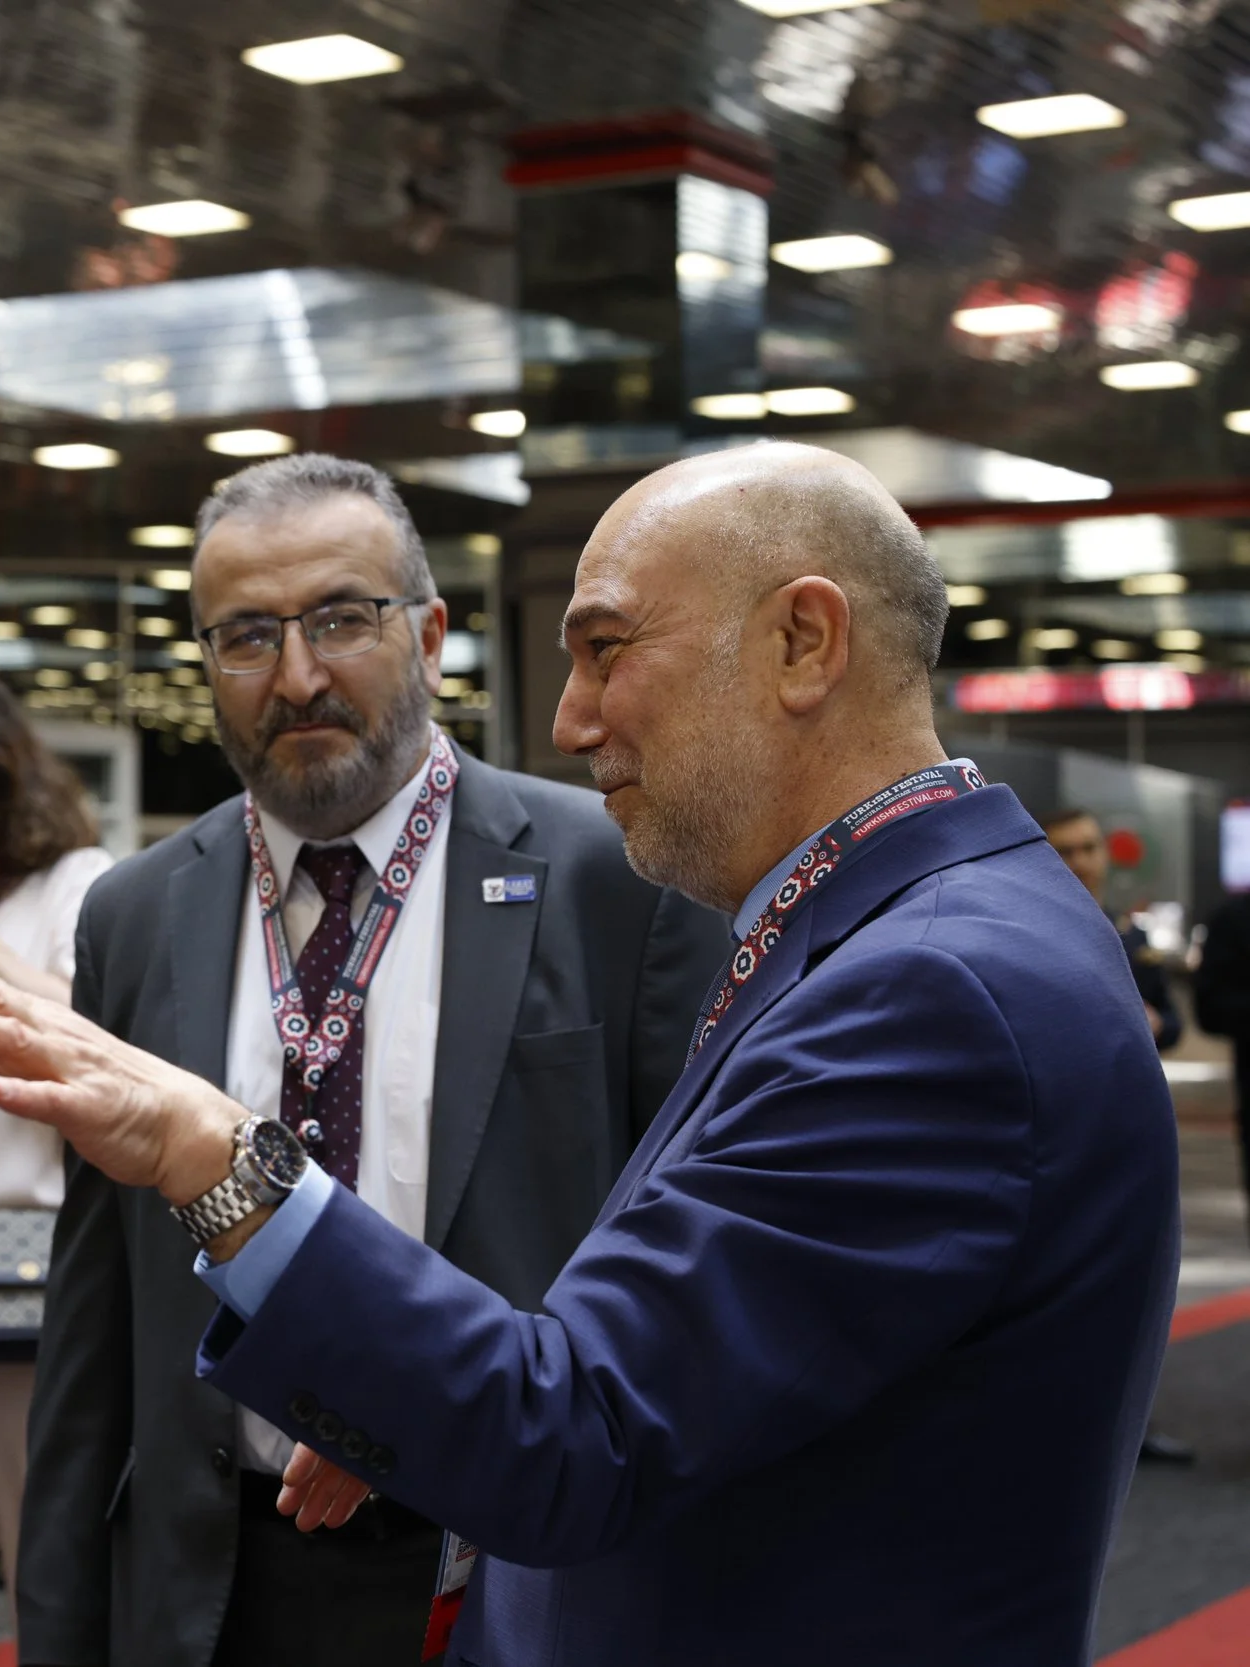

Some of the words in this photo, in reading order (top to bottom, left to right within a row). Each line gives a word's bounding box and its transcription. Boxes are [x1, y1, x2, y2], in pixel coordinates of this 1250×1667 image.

[854, 804, 884, 826] CULTURAL
[883, 789, 911, 806] HERITAGE
[911, 779, 948, 792] CONVENTION
[854, 789, 954, 837] TURKISHFESTIVAL.COM
